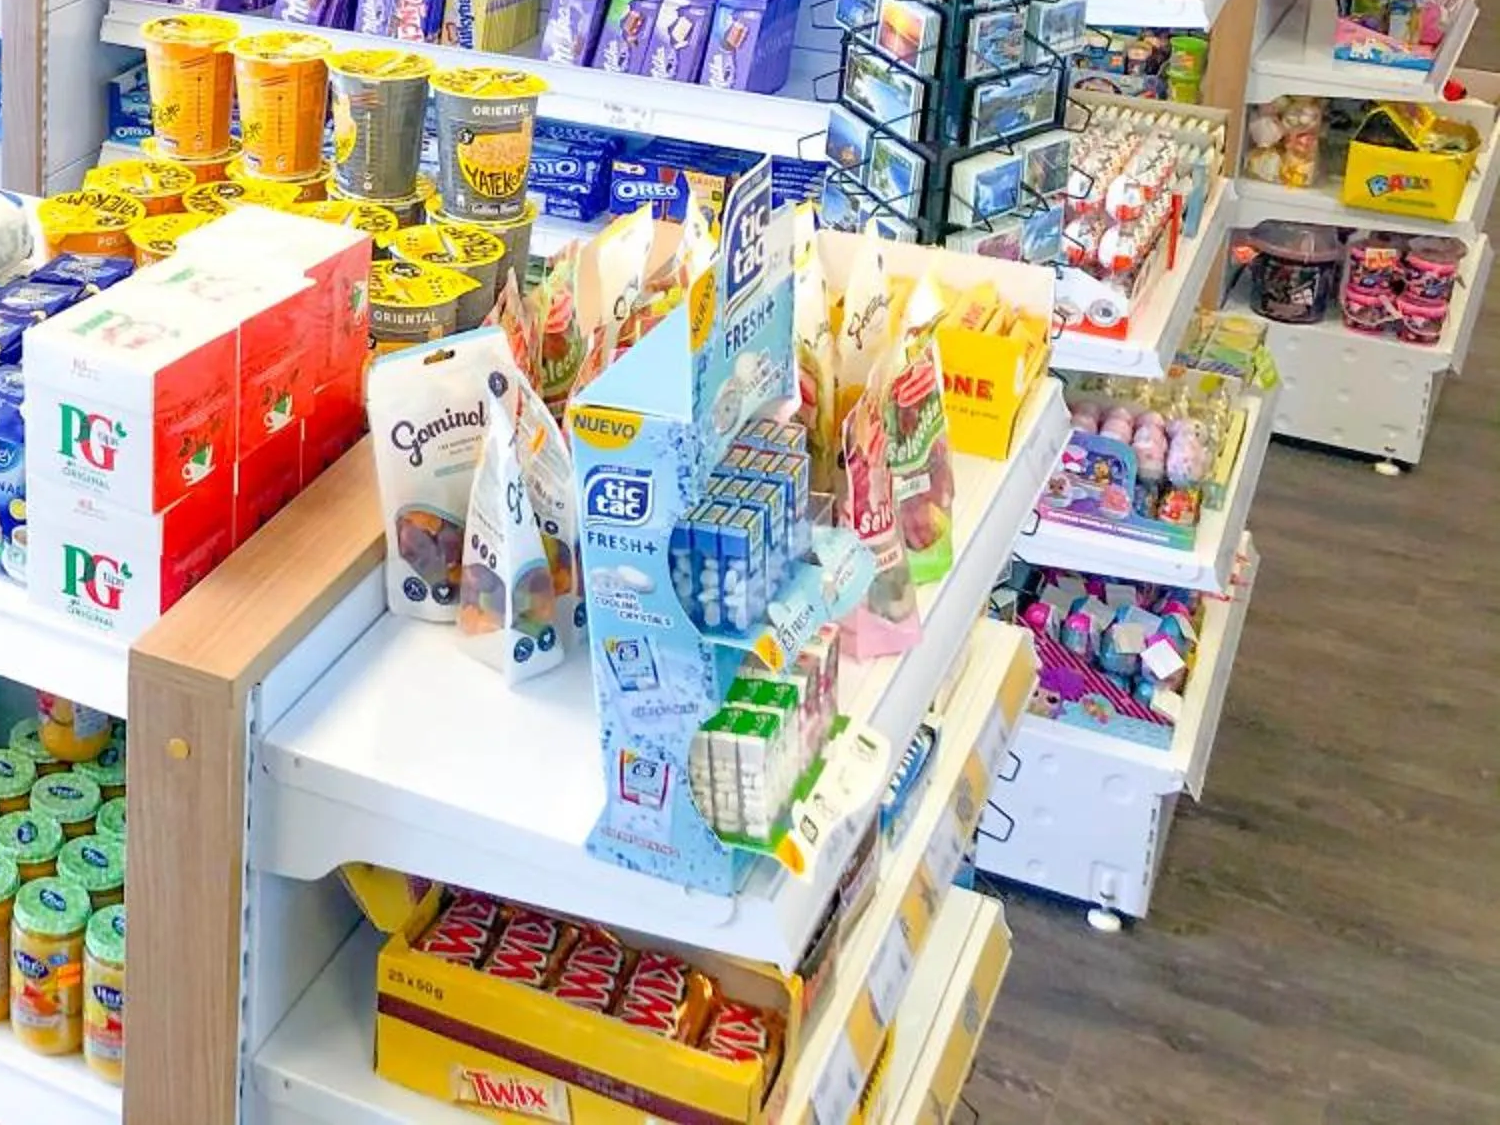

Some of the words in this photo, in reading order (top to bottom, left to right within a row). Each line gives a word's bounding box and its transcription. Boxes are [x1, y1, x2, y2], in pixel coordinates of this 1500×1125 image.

[472, 103, 530, 118] ORIENTAL
[617, 181, 679, 199] OREO
[739, 203, 767, 242] tic
[733, 236, 766, 284] tac
[373, 310, 438, 324] ORIENTAL
[724, 297, 775, 358] FRESH+
[58, 402, 119, 473] PG
[573, 414, 636, 441] NUEVO
[603, 480, 642, 504] tic
[595, 497, 642, 520] tac
[586, 530, 658, 555] FRESH+
[62, 543, 122, 611] PG
[94, 986, 125, 1008] Her
